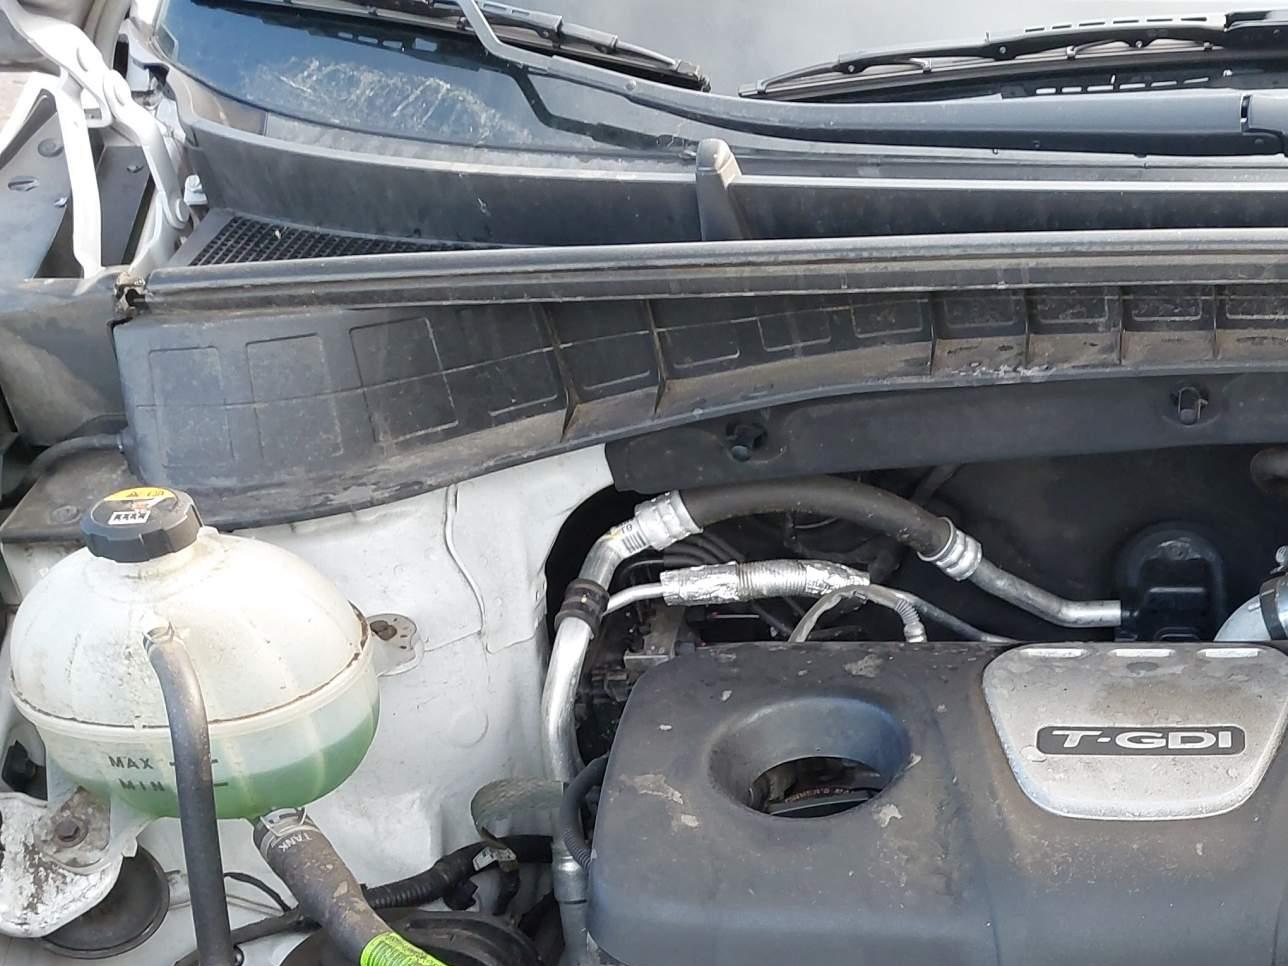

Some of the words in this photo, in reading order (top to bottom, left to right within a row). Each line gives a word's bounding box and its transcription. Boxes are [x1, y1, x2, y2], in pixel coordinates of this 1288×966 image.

[1052, 730, 1232, 750] T-GDI
[108, 755, 154, 770] MAX
[118, 778, 166, 792] MIN
